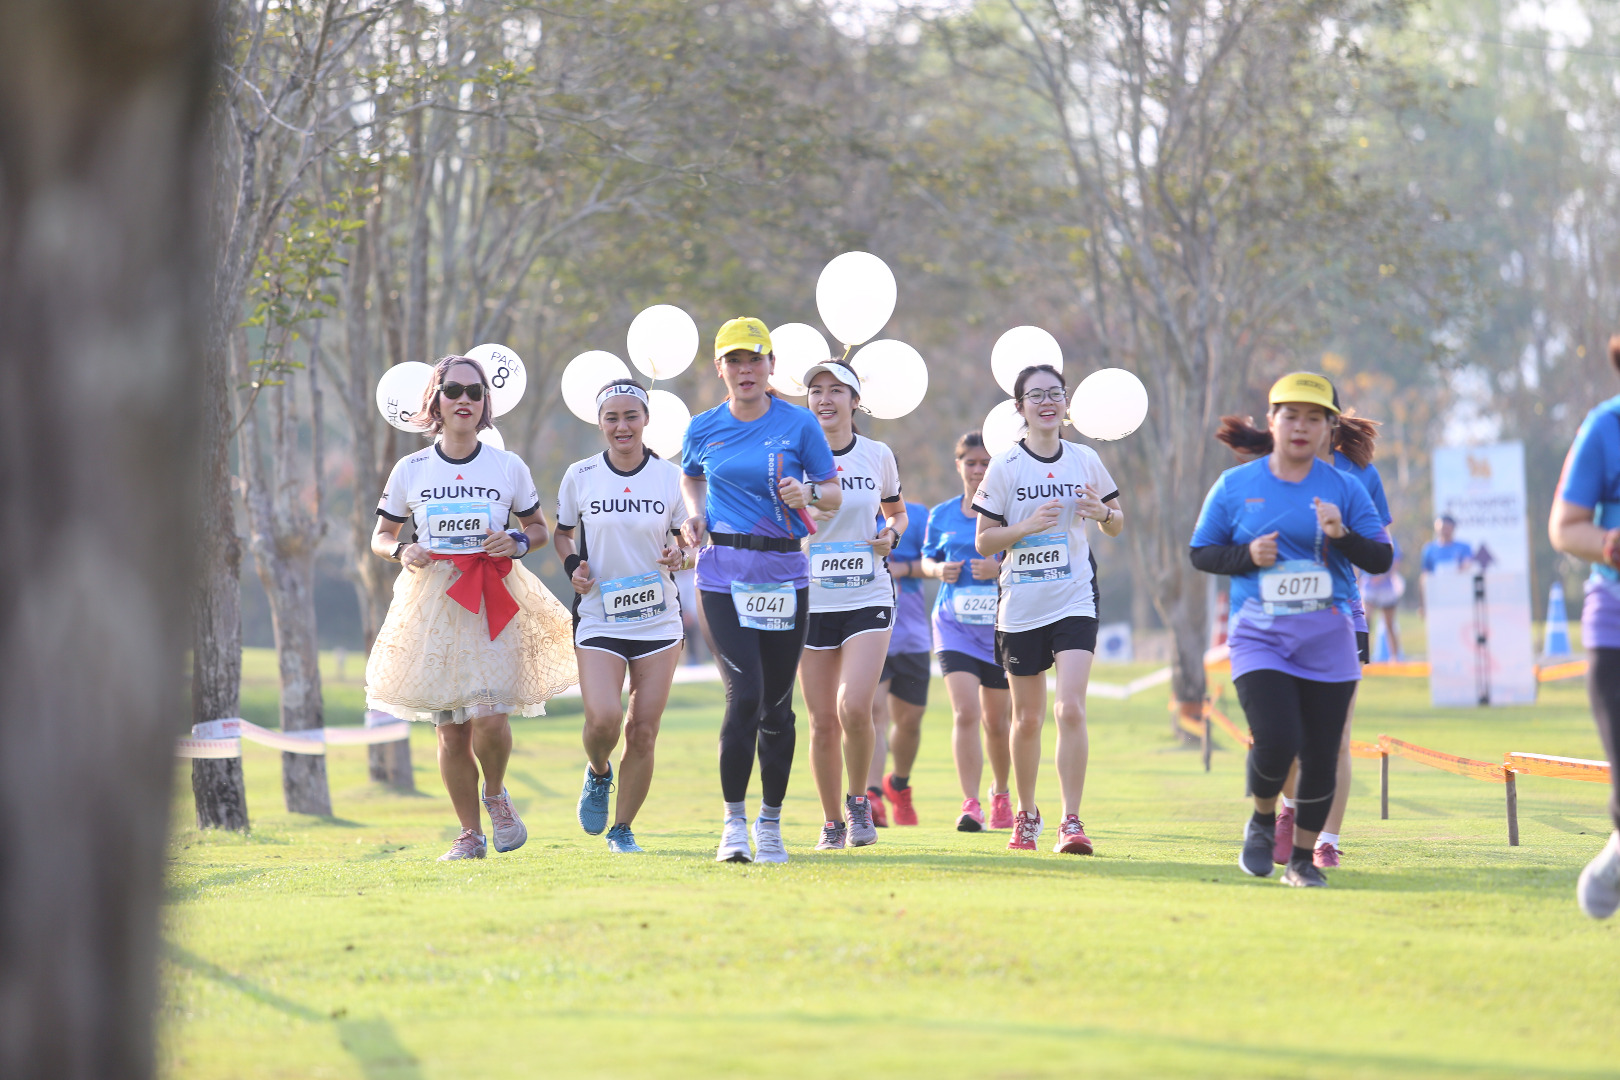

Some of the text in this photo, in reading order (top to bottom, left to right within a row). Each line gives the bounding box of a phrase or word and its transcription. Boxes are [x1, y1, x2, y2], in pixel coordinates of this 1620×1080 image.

[490, 351, 521, 377] PACE
[491, 366, 510, 389] 8
[605, 386, 636, 398] FILA
[841, 476, 876, 491] NTO
[420, 485, 501, 503] SUUNTO
[1016, 483, 1083, 502] SUUNTO
[590, 499, 665, 515] SUUNTO
[774, 506, 783, 522] RUN
[438, 518, 481, 532] PACER
[821, 557, 864, 571] PACER
[1018, 549, 1060, 566] PACER
[1277, 577, 1319, 596] 6071
[614, 589, 655, 609] PACER
[746, 596, 785, 613] 6041
[963, 598, 997, 611] 6242
